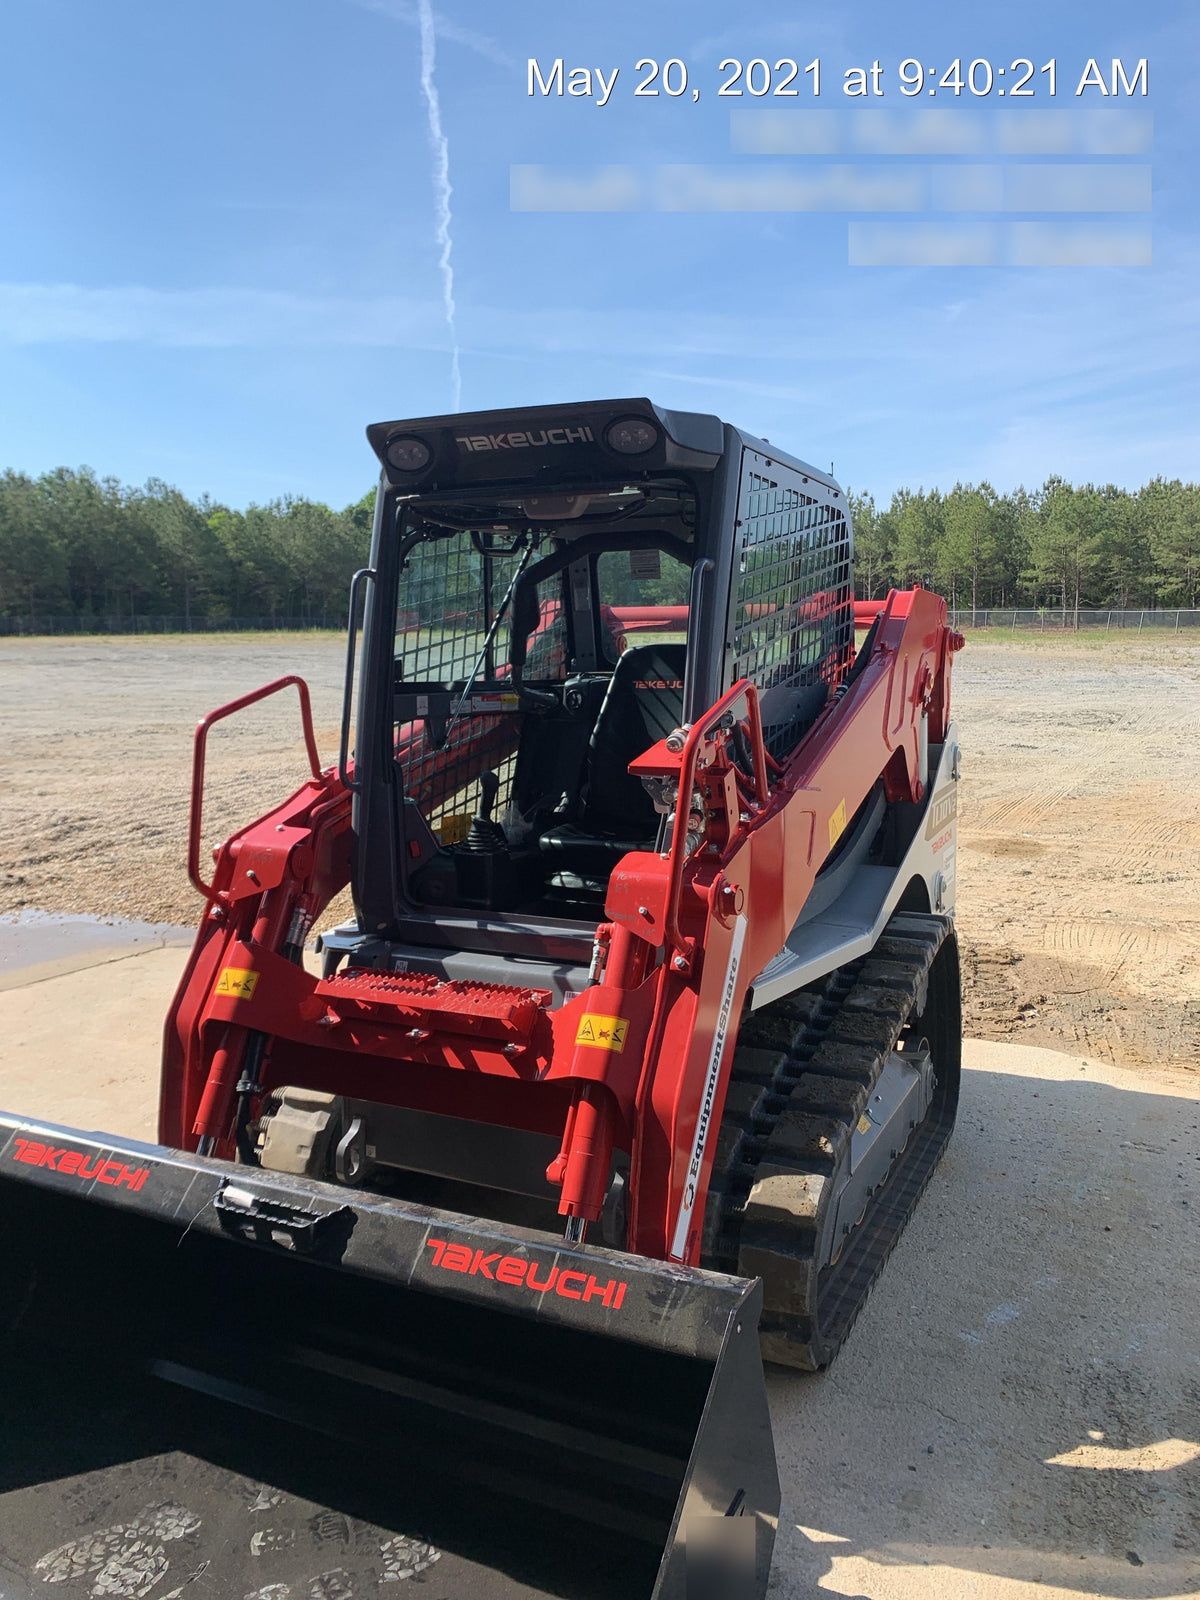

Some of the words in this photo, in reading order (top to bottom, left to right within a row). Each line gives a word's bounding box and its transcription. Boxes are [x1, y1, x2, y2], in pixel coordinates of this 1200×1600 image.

[456, 426, 594, 452] TAKEUCHI
[632, 680, 684, 689] TAKEUC
[690, 957, 738, 1179] EquipmentShare
[13, 1138, 150, 1191] TAKEUCHI
[426, 1238, 628, 1310] TAKEUCHI
